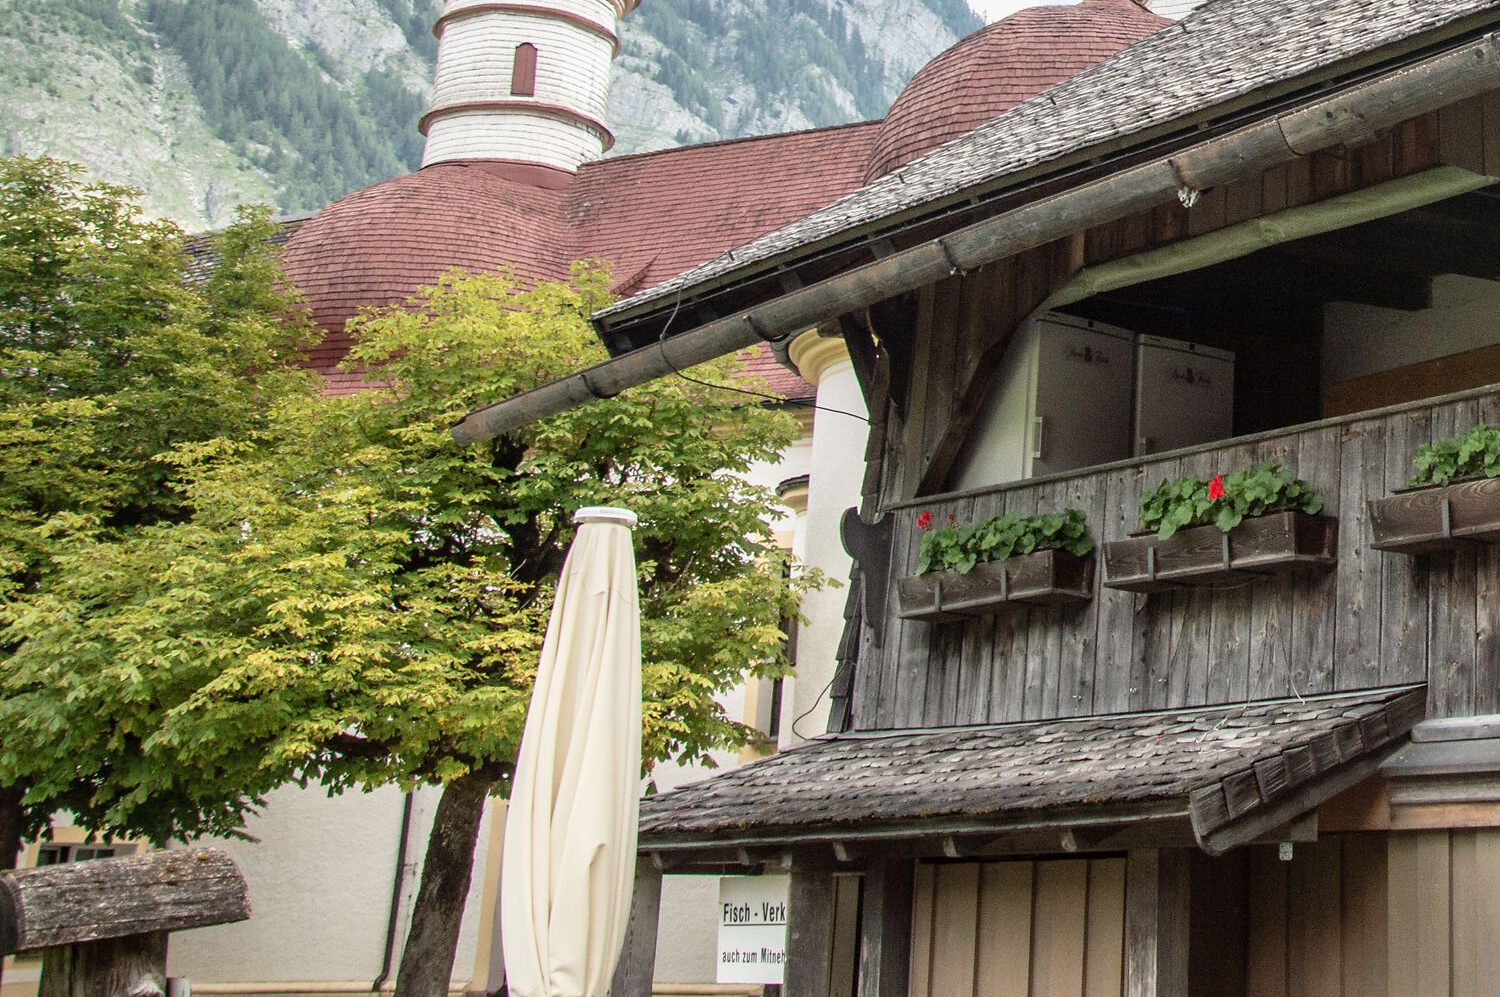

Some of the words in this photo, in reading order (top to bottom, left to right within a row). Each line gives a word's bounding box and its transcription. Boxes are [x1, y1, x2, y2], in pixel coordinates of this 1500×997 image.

[723, 903, 750, 922] Fisch
[762, 902, 786, 922] Verk
[722, 948, 740, 963] auch
[742, 951, 757, 963] zum
